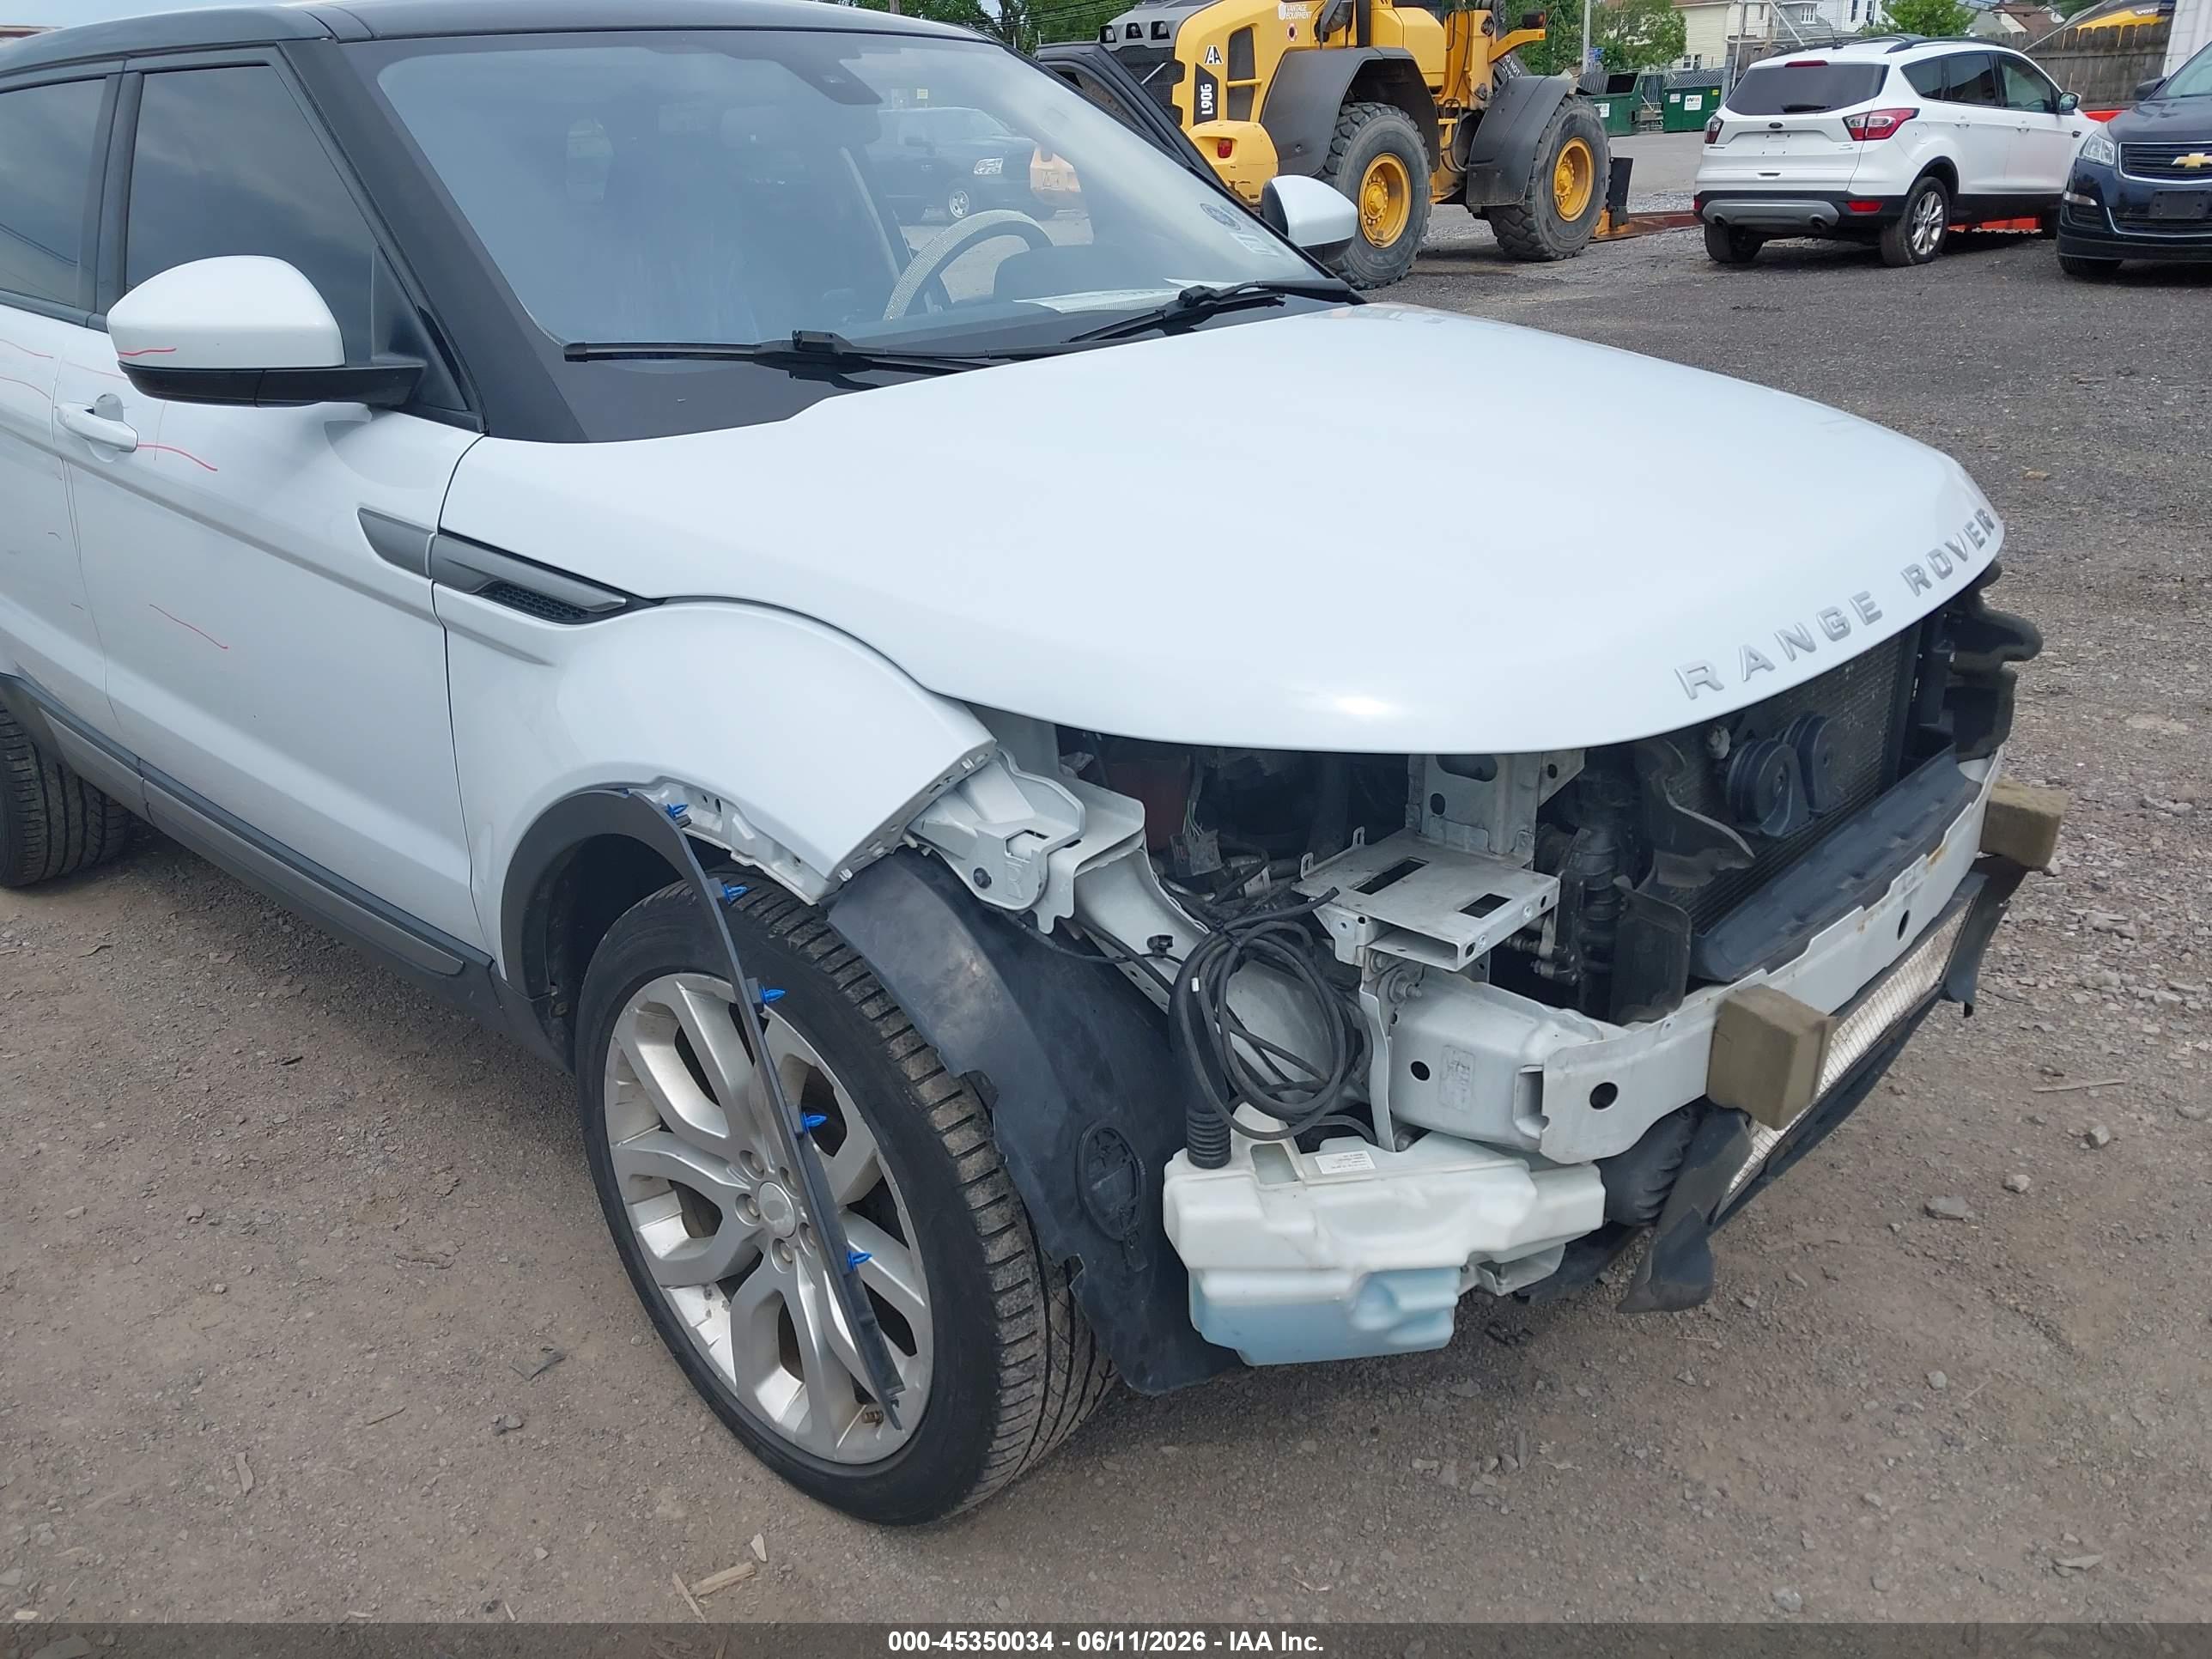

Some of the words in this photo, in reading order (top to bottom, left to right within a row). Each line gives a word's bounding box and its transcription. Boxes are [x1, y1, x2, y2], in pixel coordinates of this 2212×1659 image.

[1200, 83, 1213, 115] L90G
[1674, 590, 1883, 700] RANGE
[1900, 507, 1995, 597] ROVER
